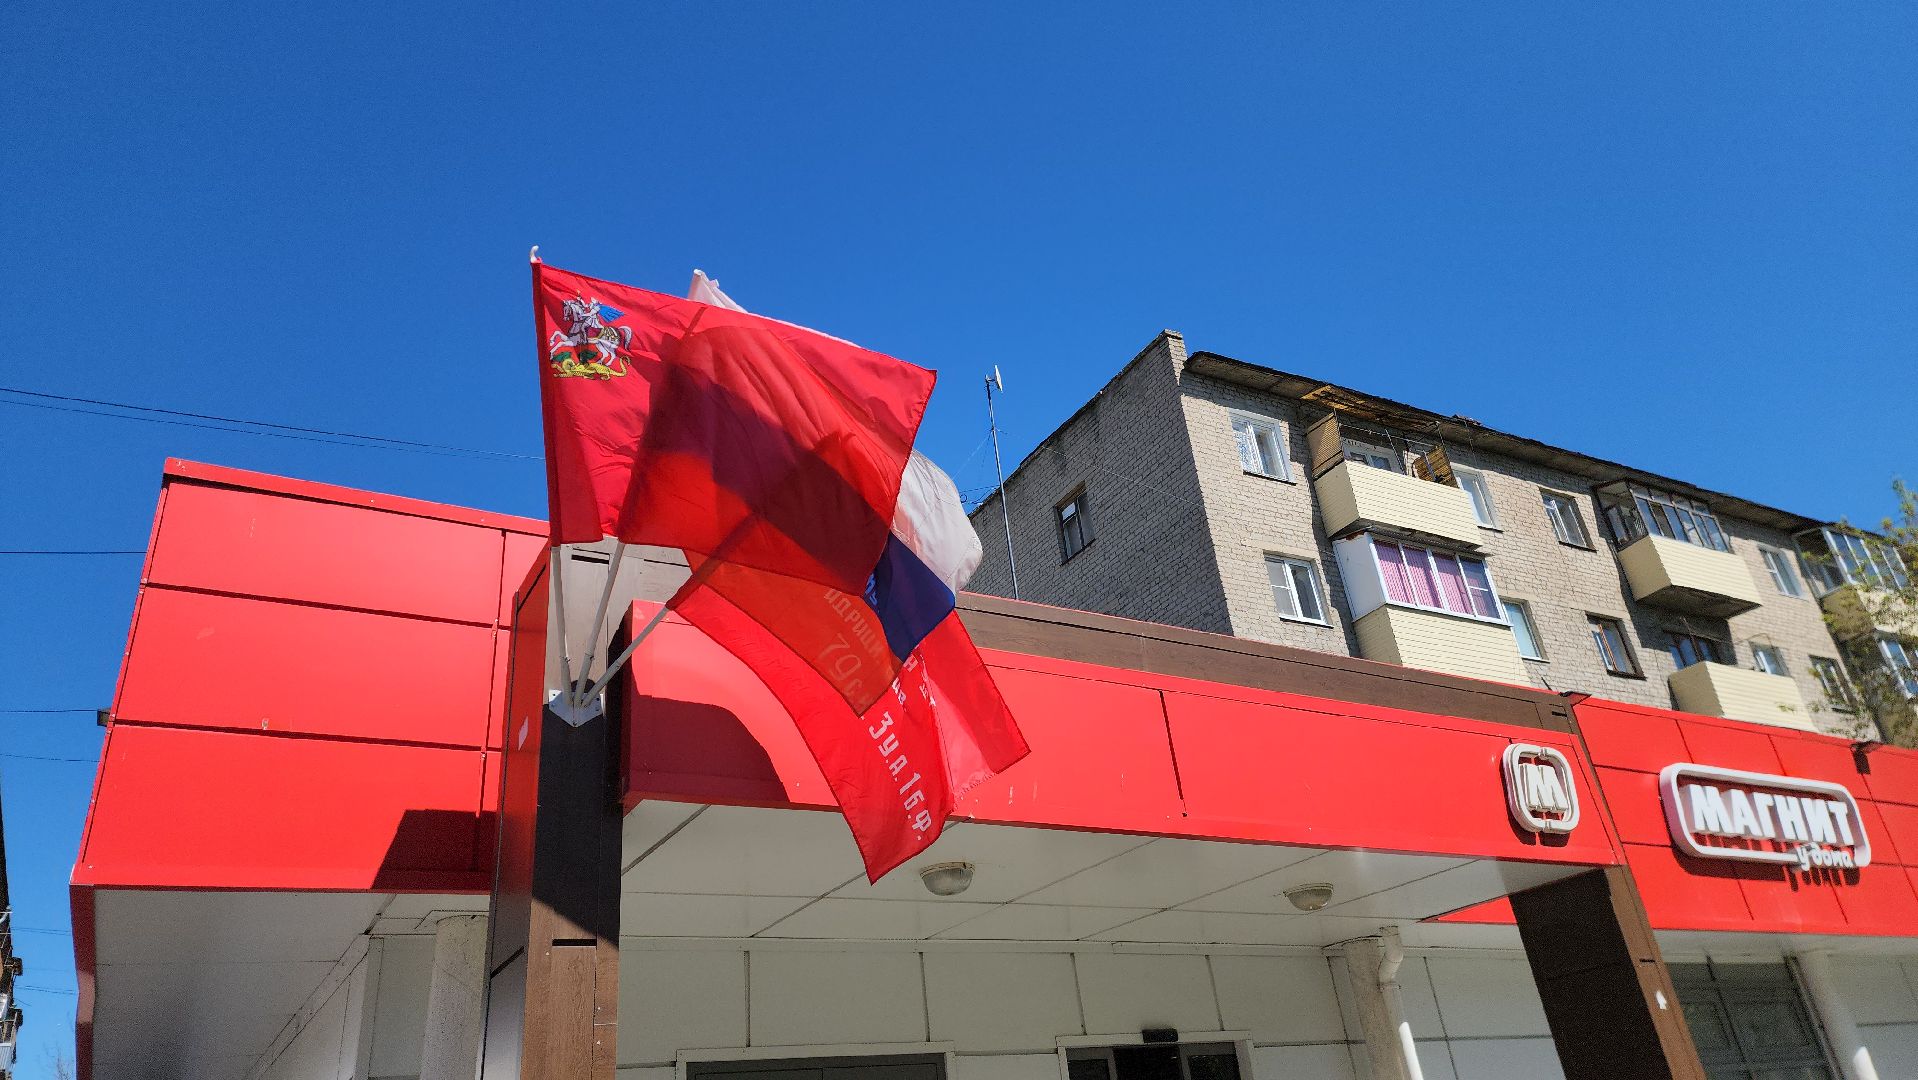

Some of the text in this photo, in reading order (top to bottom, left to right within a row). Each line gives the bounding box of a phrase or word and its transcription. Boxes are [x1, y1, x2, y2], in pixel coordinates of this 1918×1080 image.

[1520, 763, 1570, 811] М
[1685, 783, 1855, 846] МАГНИТ
[1809, 841, 1855, 868] дома
